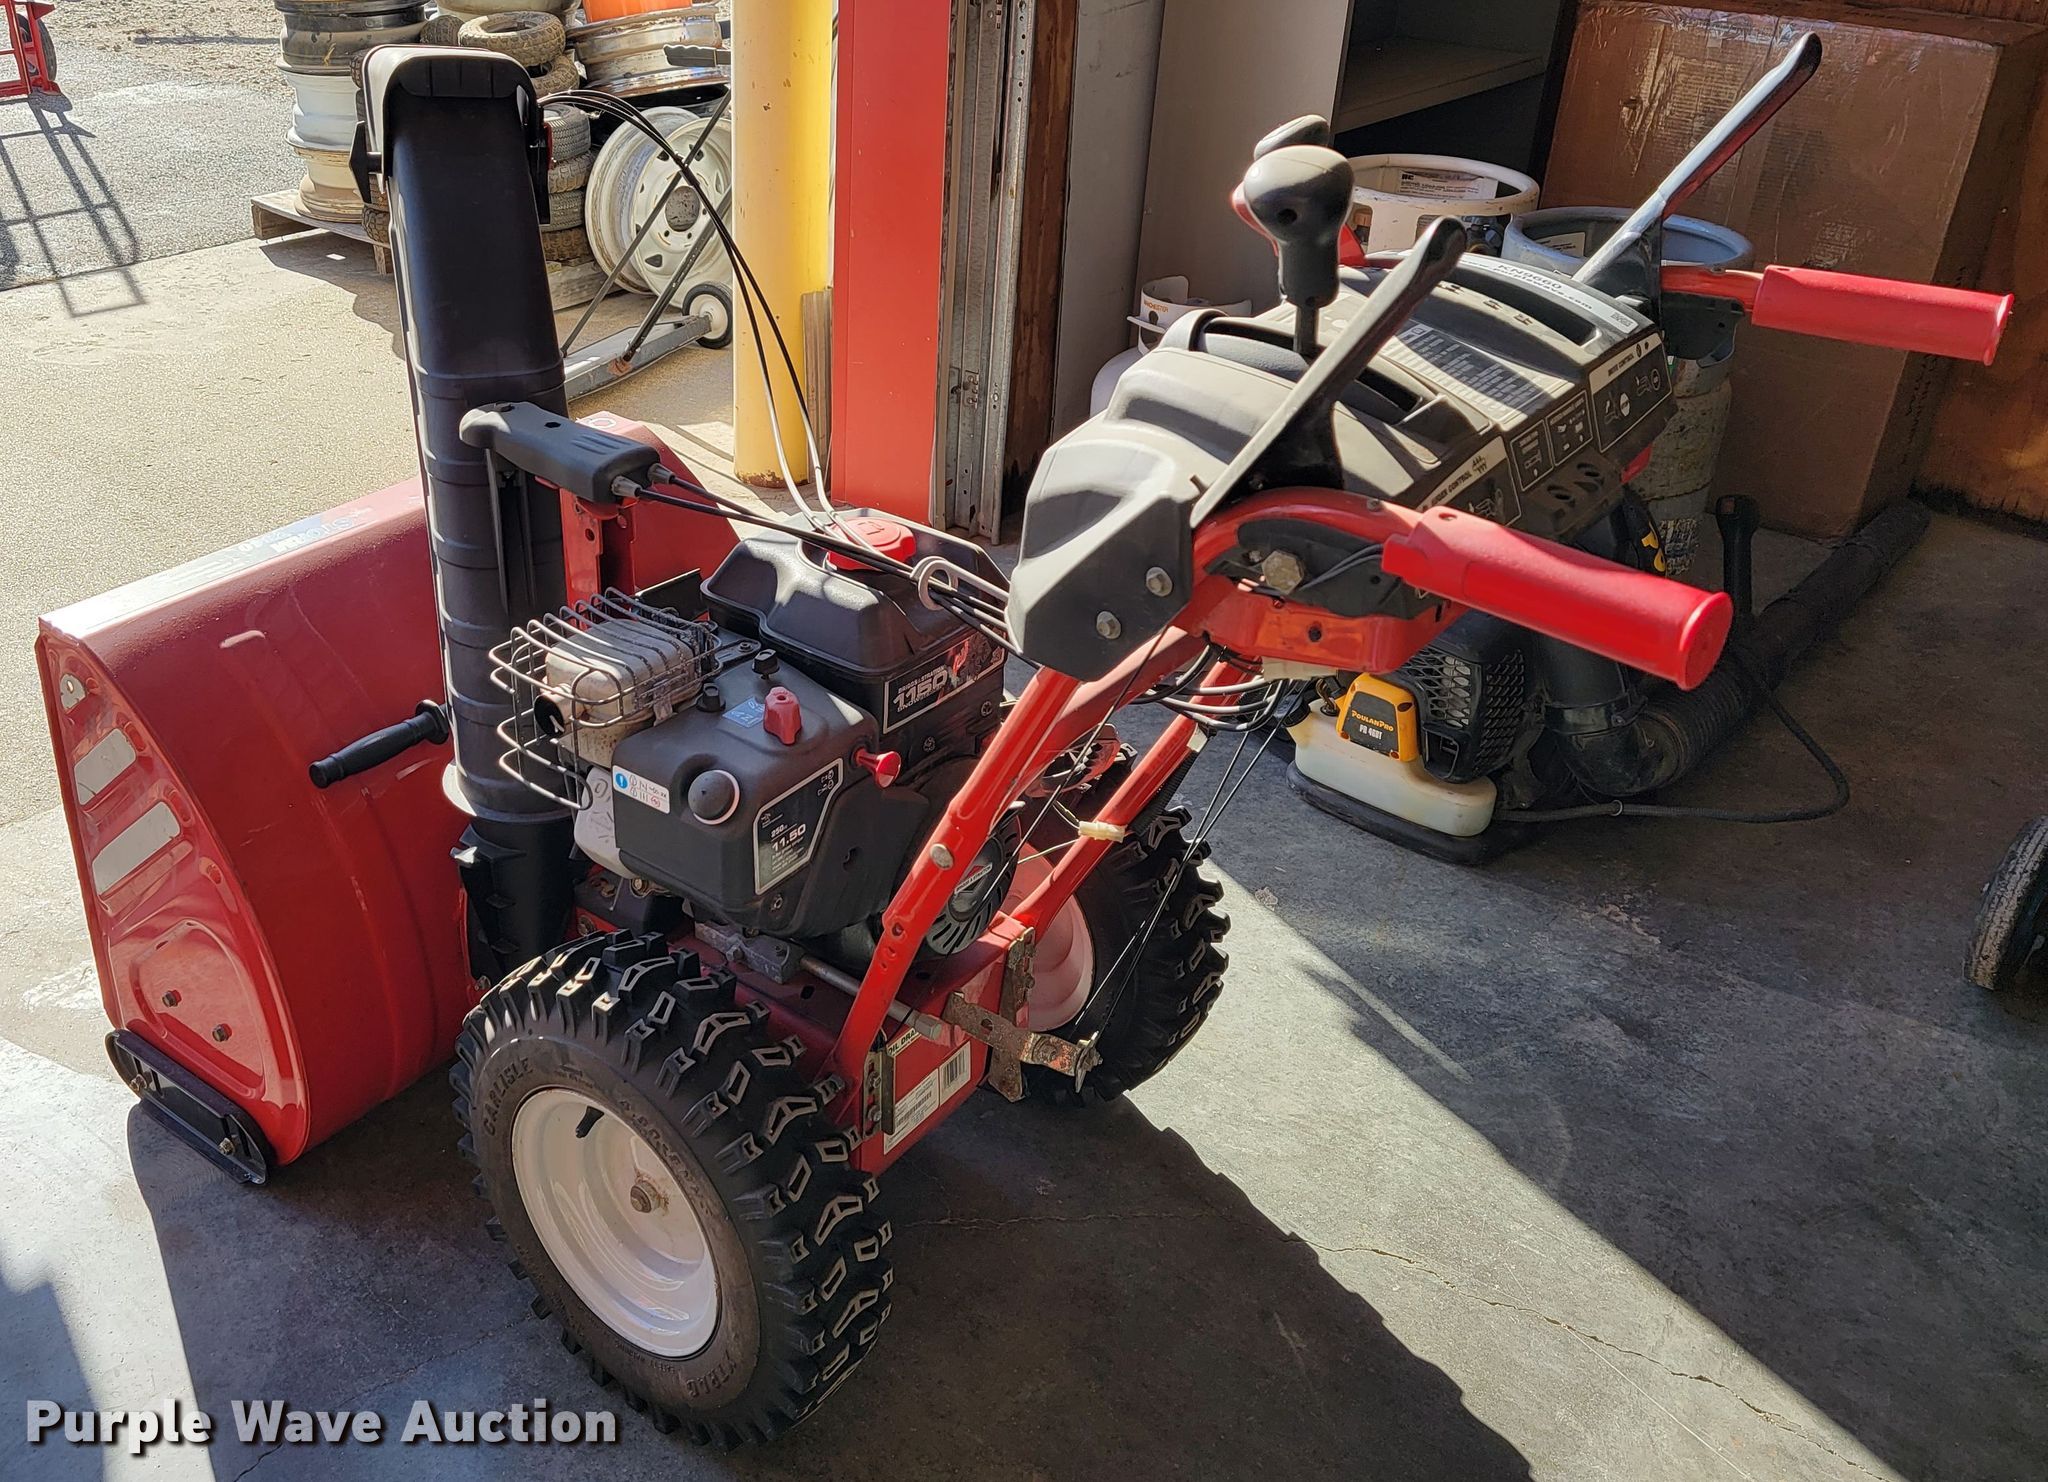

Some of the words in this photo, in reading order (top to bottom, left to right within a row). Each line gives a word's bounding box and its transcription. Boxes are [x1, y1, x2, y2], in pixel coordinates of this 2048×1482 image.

[892, 669, 948, 709] 1150
[772, 823, 806, 852] 11.50
[484, 1057, 533, 1136] CARLISLE
